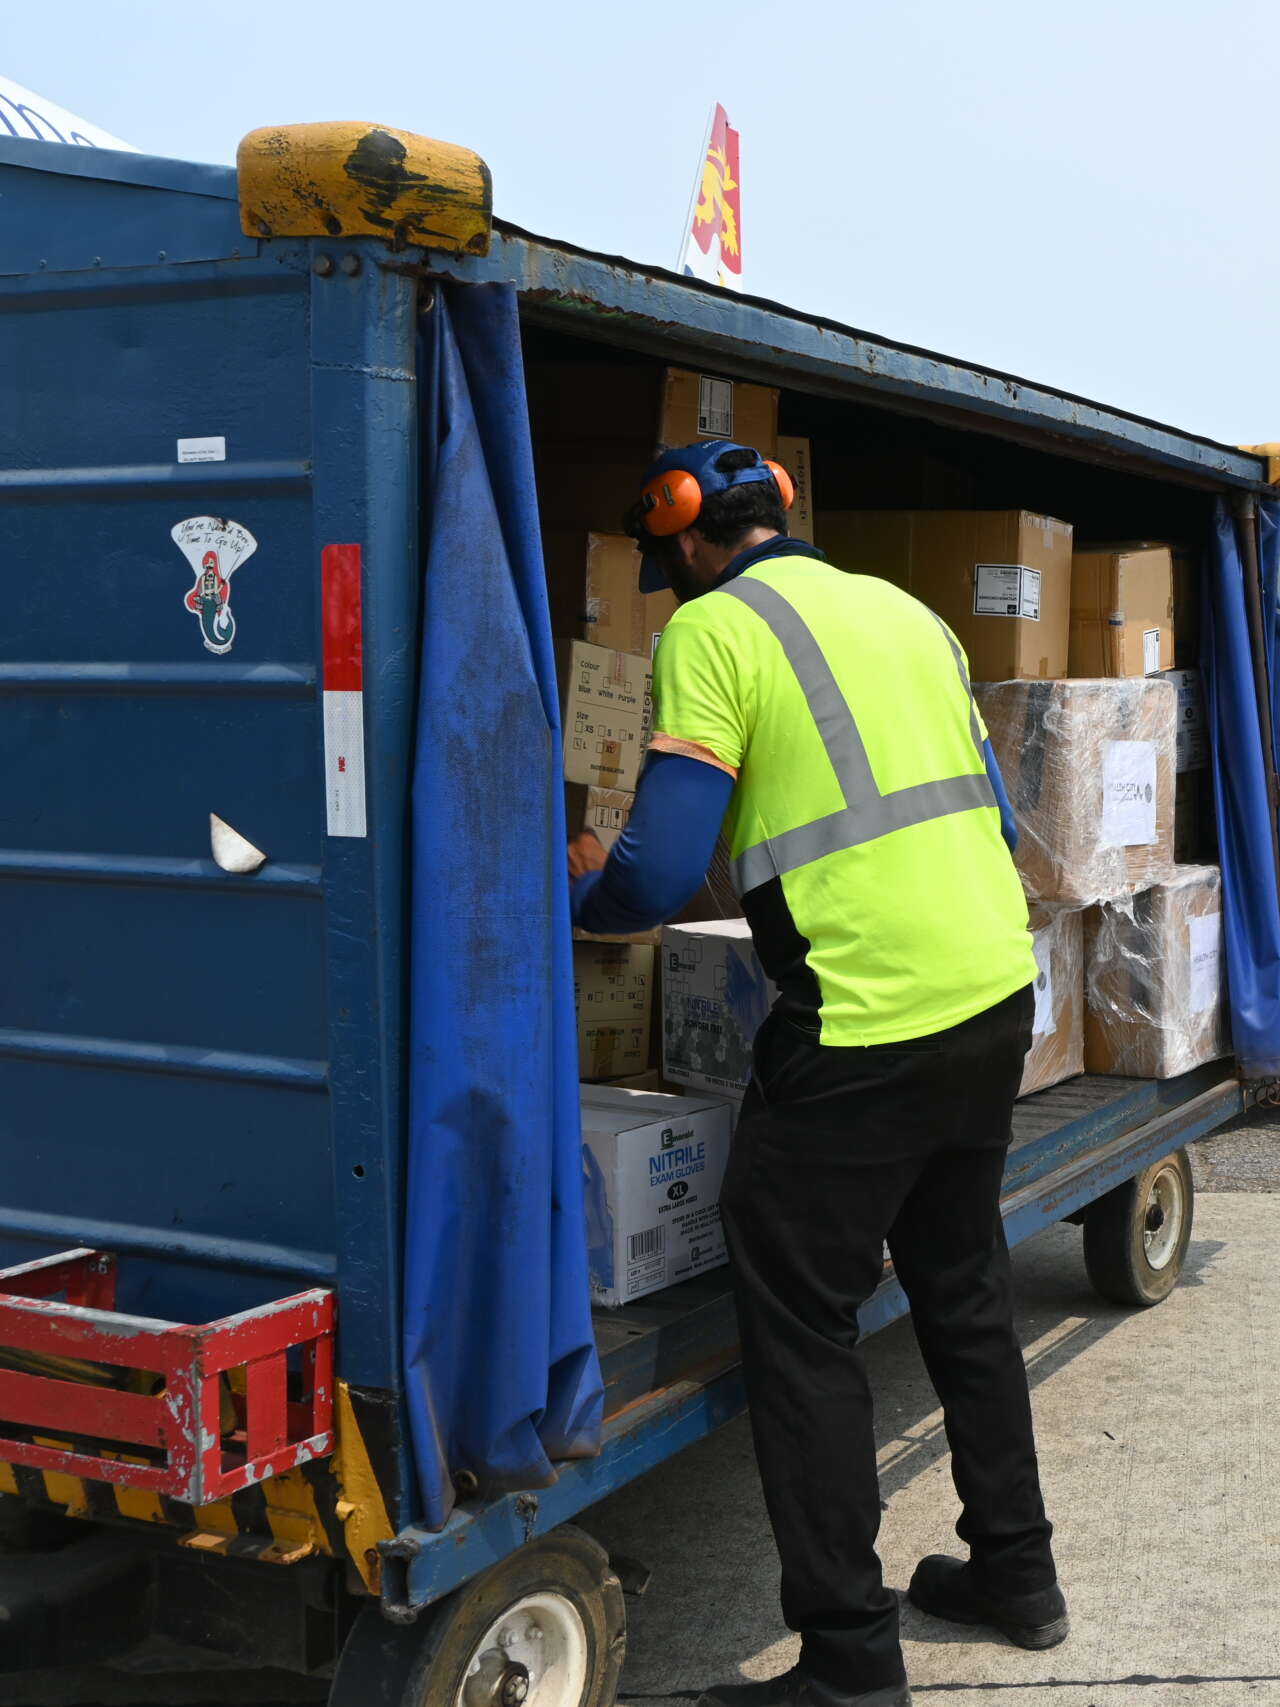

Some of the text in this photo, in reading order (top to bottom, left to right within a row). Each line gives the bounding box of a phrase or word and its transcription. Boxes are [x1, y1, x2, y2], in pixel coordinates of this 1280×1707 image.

[598, 689, 614, 699] White
[618, 694, 637, 704] Purple
[576, 711, 589, 721] Size
[585, 725, 594, 733] XS
[338, 756, 346, 773] 3M
[660, 1128, 694, 1150] Emerald
[649, 1141, 705, 1175] NITRILE
[650, 1161, 705, 1187] EXAM GLOVES
[672, 1183, 684, 1199] XL
